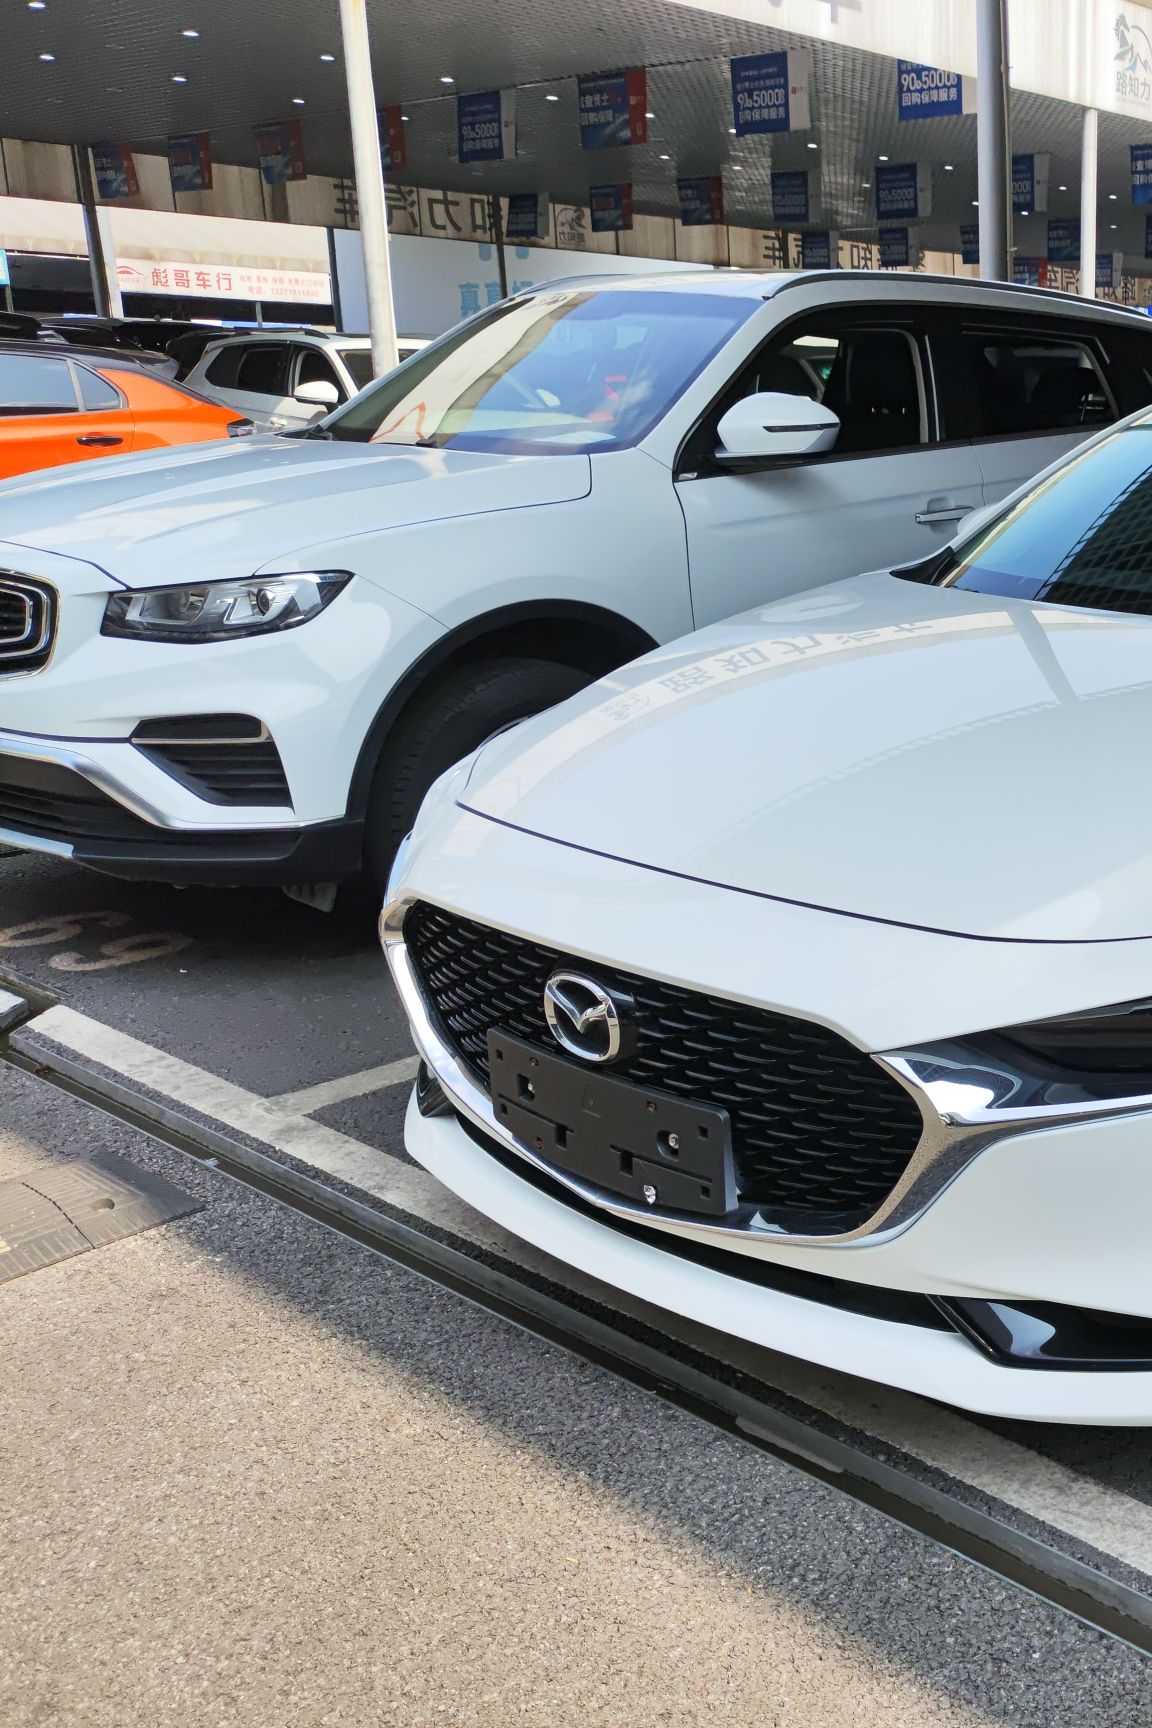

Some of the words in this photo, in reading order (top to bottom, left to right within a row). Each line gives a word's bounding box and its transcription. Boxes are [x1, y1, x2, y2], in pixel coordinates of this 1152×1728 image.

[902, 88, 958, 107] 回购保障服务
[1116, 71, 1151, 101] 路知力
[151, 267, 232, 291] 彪哥车行
